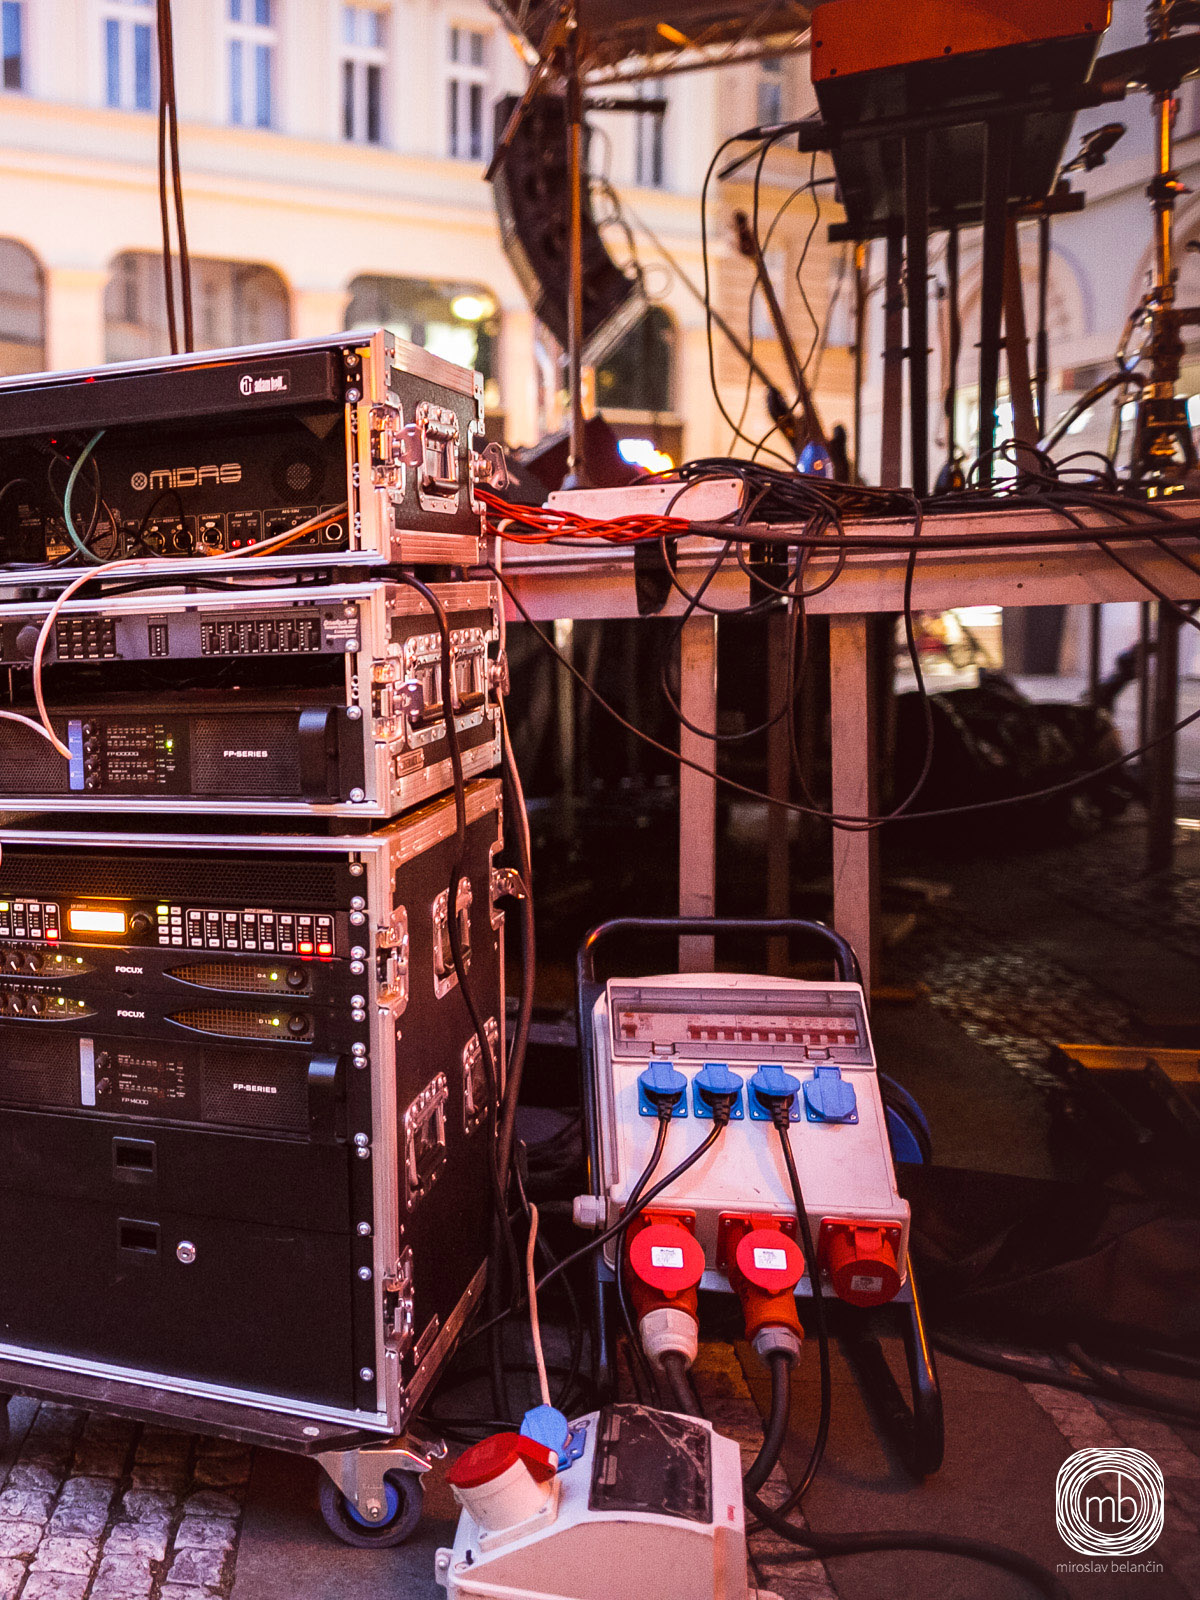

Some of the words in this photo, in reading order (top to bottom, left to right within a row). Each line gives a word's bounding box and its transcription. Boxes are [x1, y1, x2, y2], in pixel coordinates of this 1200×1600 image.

[149, 462, 242, 490] MIDAS
[115, 965, 143, 975] FOCUX
[117, 1009, 145, 1019] FOCUX
